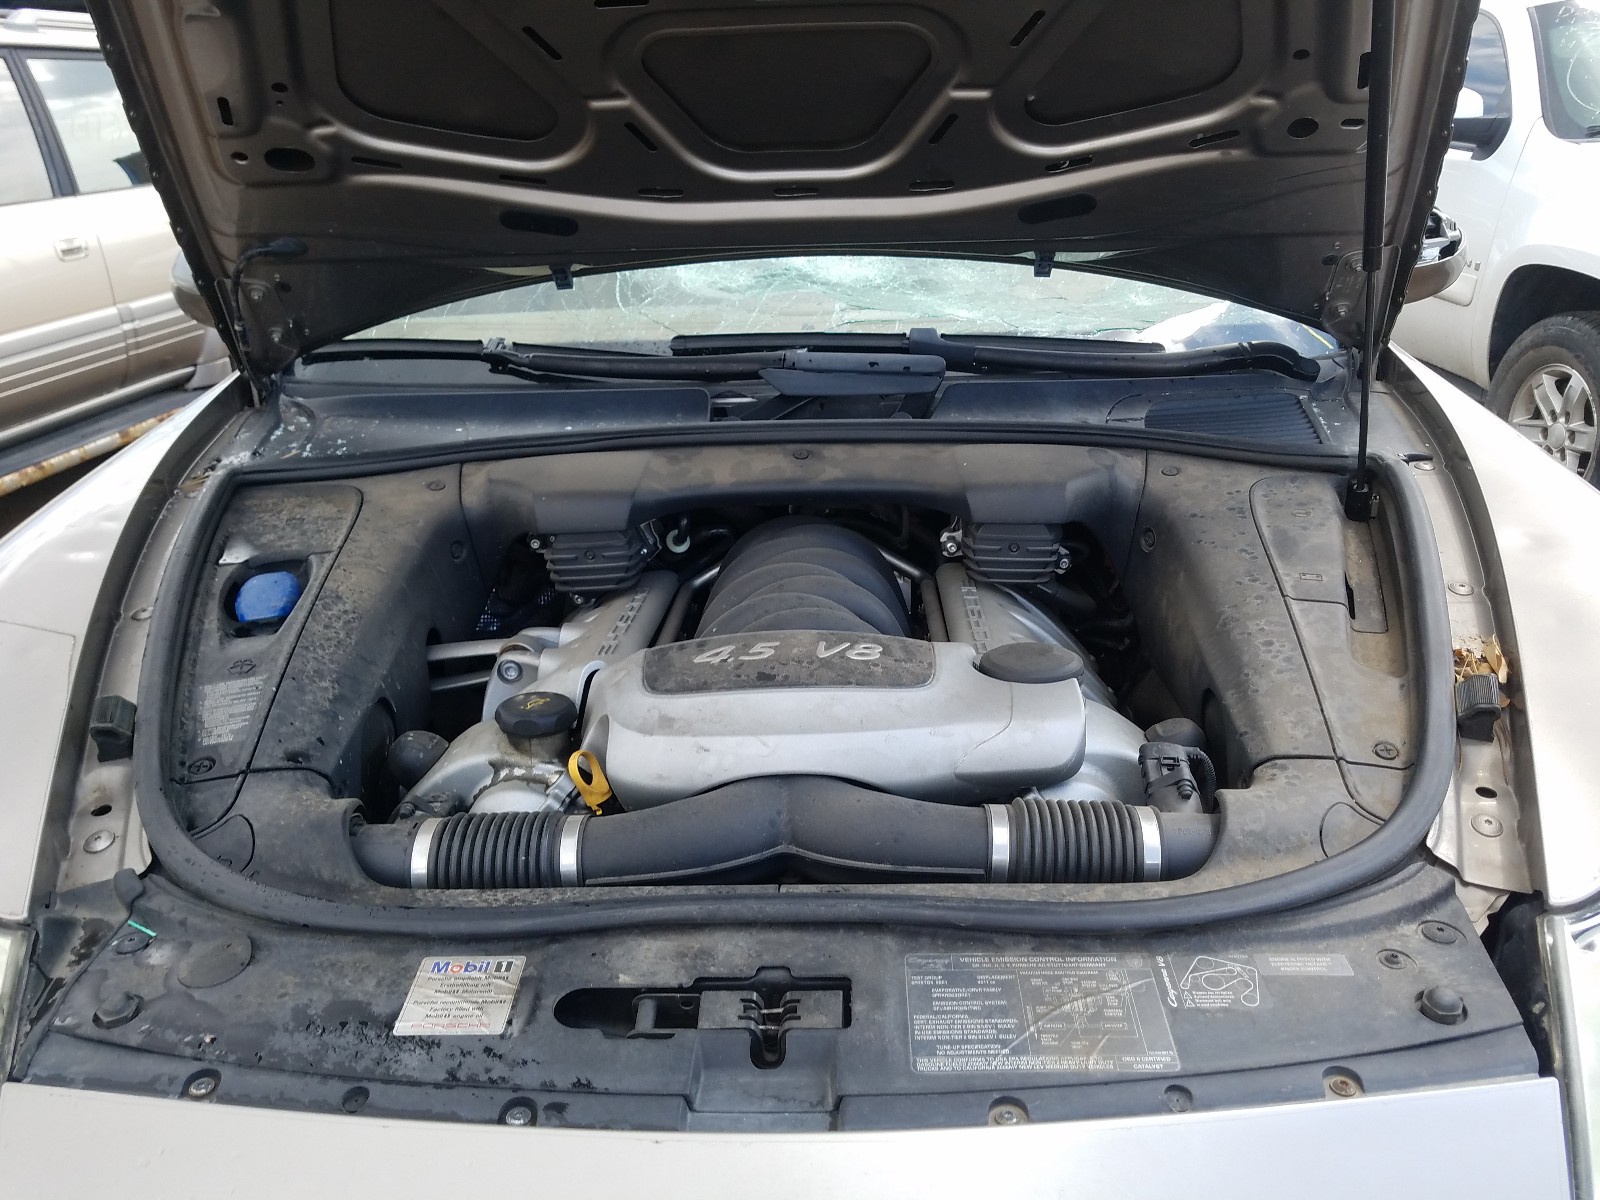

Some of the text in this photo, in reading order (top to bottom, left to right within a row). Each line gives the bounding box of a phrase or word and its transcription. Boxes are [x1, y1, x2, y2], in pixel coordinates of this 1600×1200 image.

[693, 641, 883, 664] 4.5 V8
[431, 961, 491, 974] Mobil
[1161, 968, 1178, 1007] Cayenne
